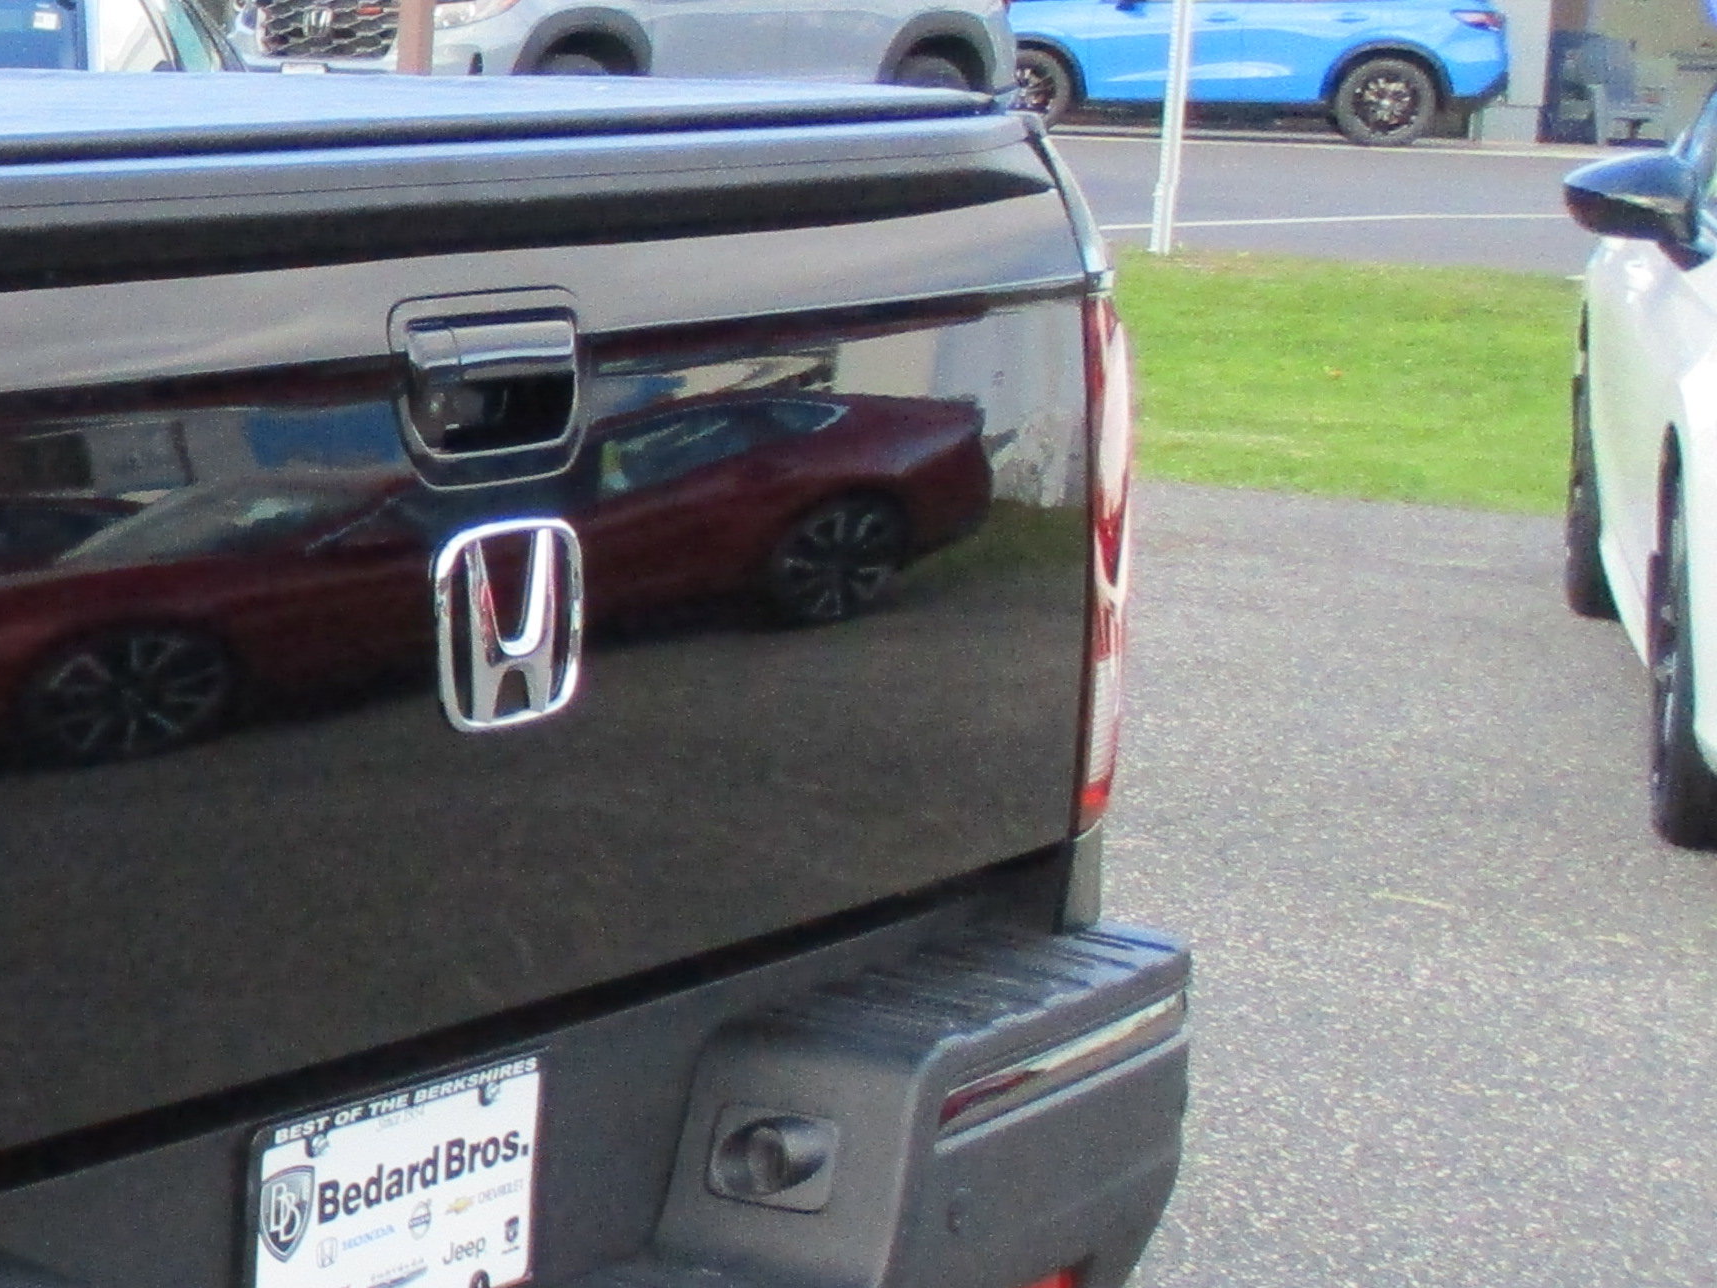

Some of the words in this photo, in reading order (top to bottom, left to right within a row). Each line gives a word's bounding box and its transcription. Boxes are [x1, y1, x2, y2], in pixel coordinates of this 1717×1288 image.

[274, 1115, 332, 1145] BEST
[334, 1106, 364, 1126] OF
[368, 1094, 410, 1117] THE
[413, 1056, 538, 1104] BERKSHIRES
[342, 1224, 395, 1251] HONDA
[442, 1237, 486, 1265] Jeep
